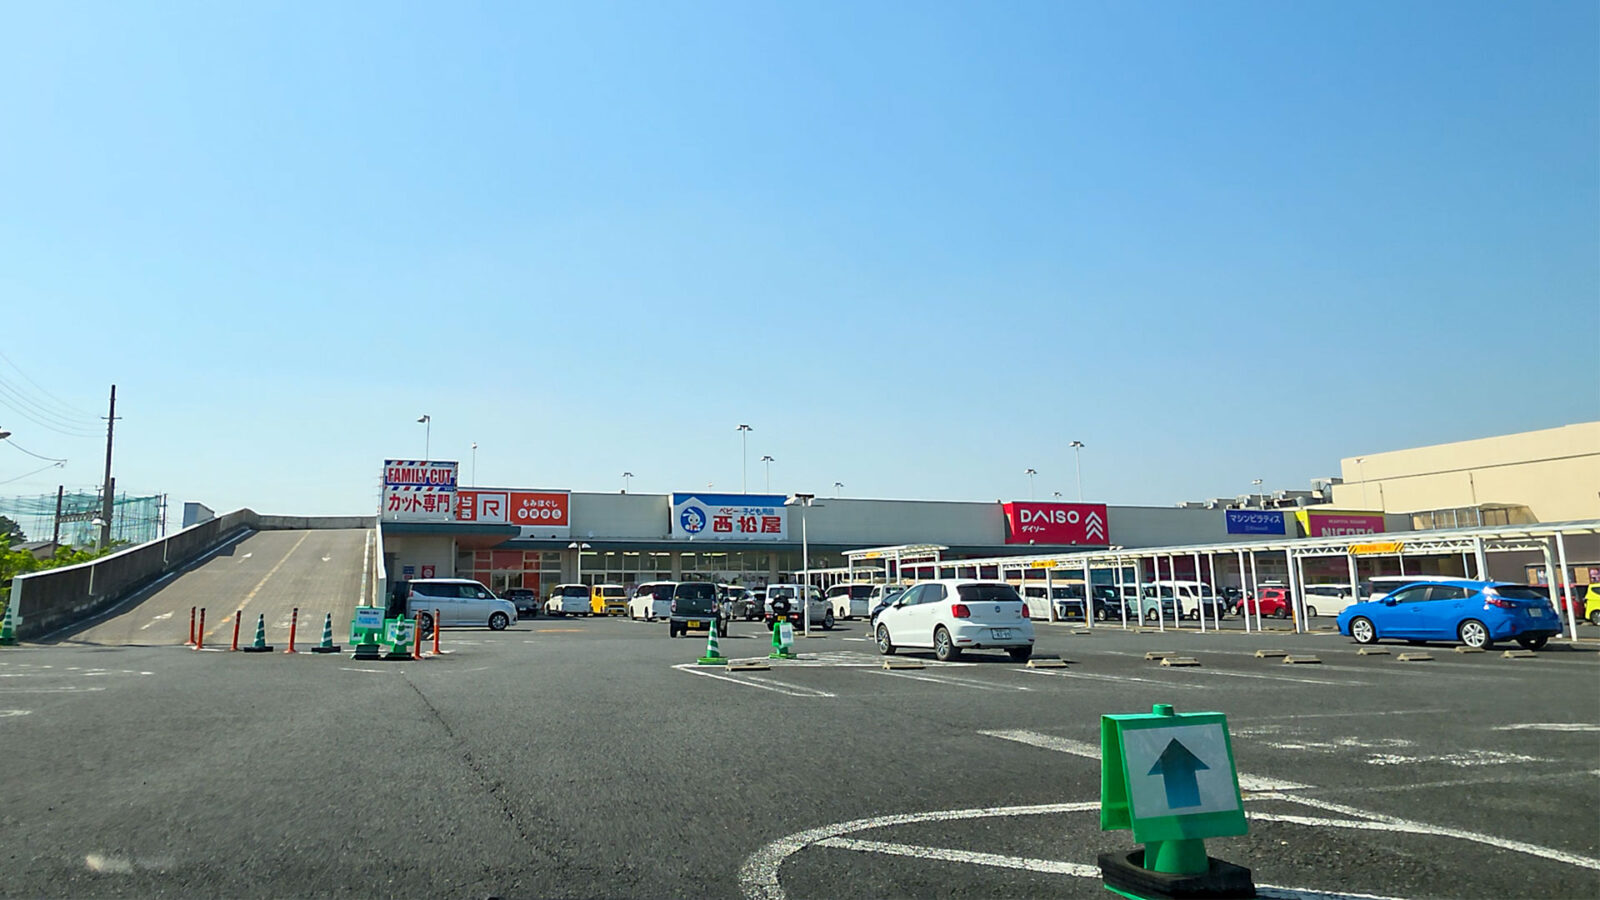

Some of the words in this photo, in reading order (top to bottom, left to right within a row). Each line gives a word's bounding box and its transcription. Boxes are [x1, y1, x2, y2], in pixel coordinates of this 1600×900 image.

[388, 468, 427, 484] FAMILY
[430, 469, 452, 484] CUT
[388, 493, 450, 513] カット専門
[713, 515, 781, 533] 西松屋
[1020, 509, 1080, 524] DAISO
[1230, 514, 1281, 524] マシンピラティス
[1021, 525, 1046, 533] ダイソー
